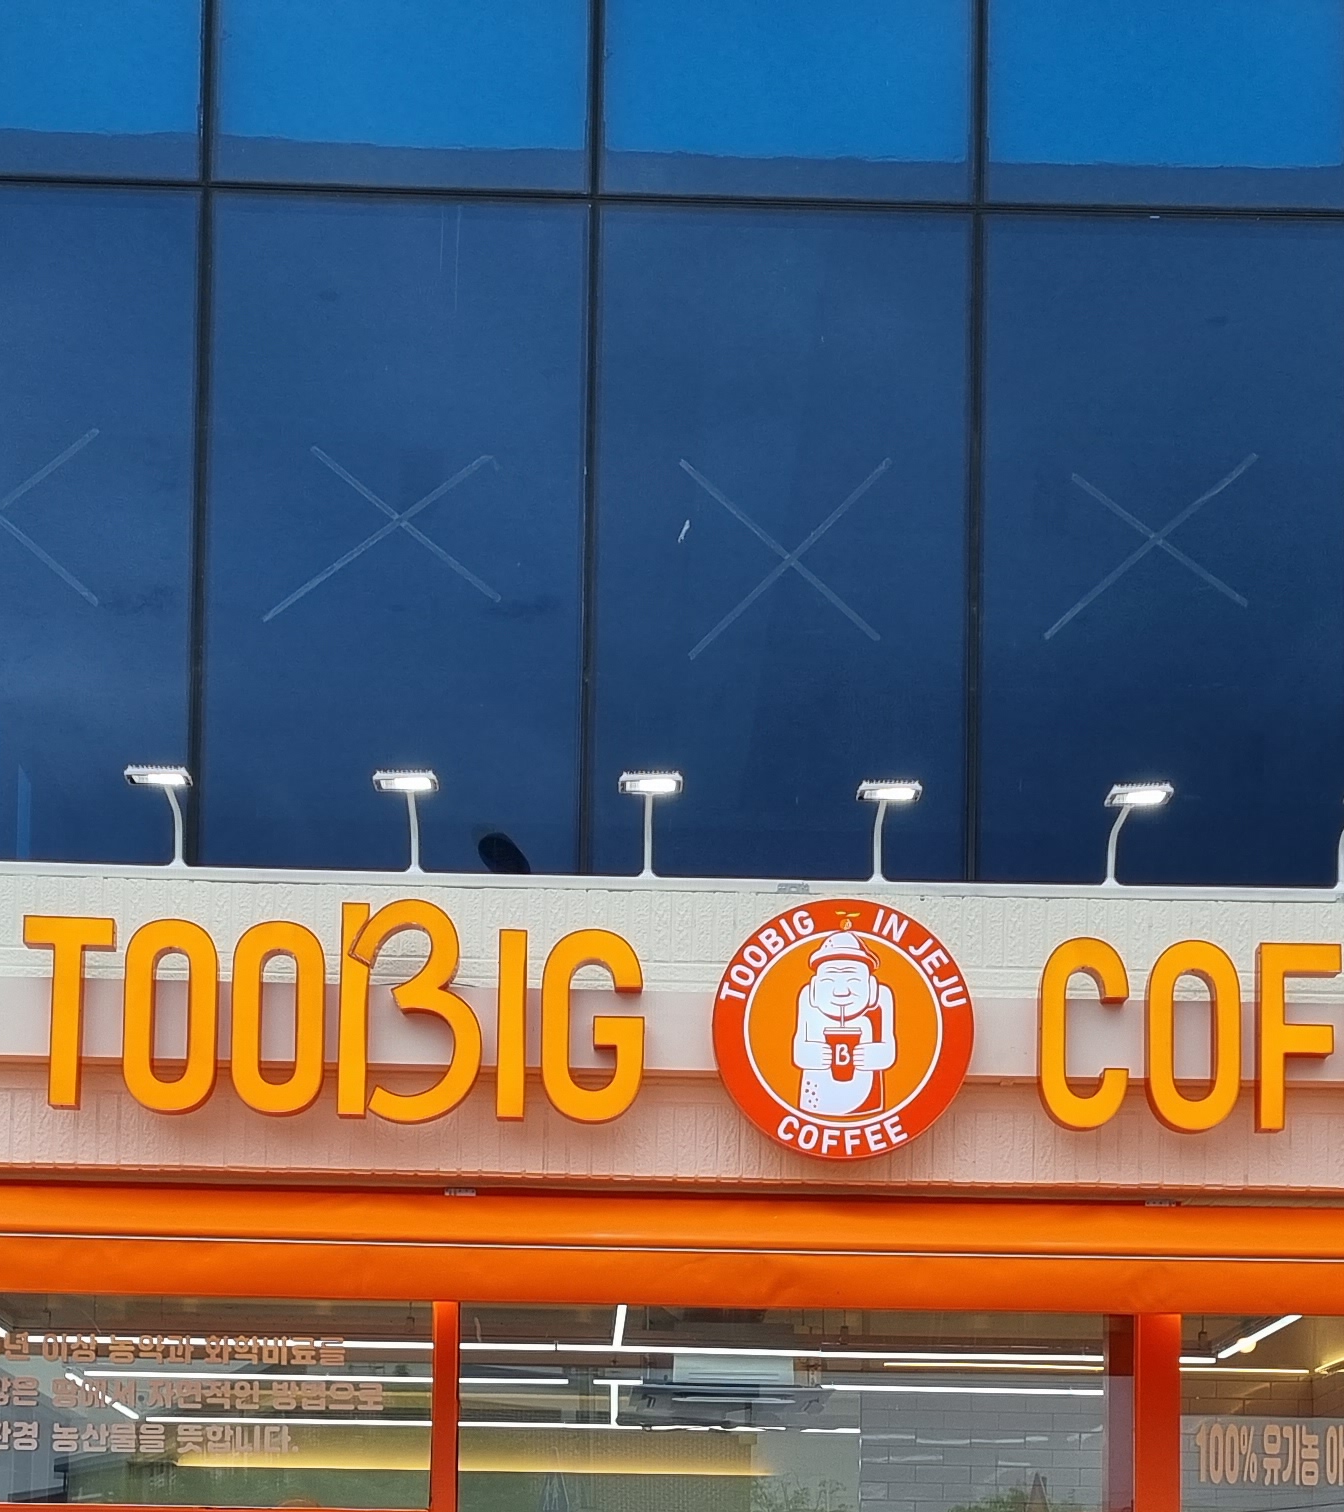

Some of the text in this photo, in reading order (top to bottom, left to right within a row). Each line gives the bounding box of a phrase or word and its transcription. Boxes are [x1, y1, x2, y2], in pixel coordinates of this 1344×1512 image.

[719, 908, 968, 1010] TOOBIG IN JEJU
[23, 898, 645, 1125] TOOBIG
[776, 1115, 910, 1156] COFFEE
[42, 1332, 97, 1362] 이상
[108, 1333, 194, 1364] 농약과
[205, 1335, 346, 1366] 화학비료를
[52, 1422, 165, 1453] 농산물을
[177, 1425, 299, 1453] 뜻합니다.
[1196, 1423, 1257, 1484] 100%
[1262, 1424, 1319, 1486] 유기농
